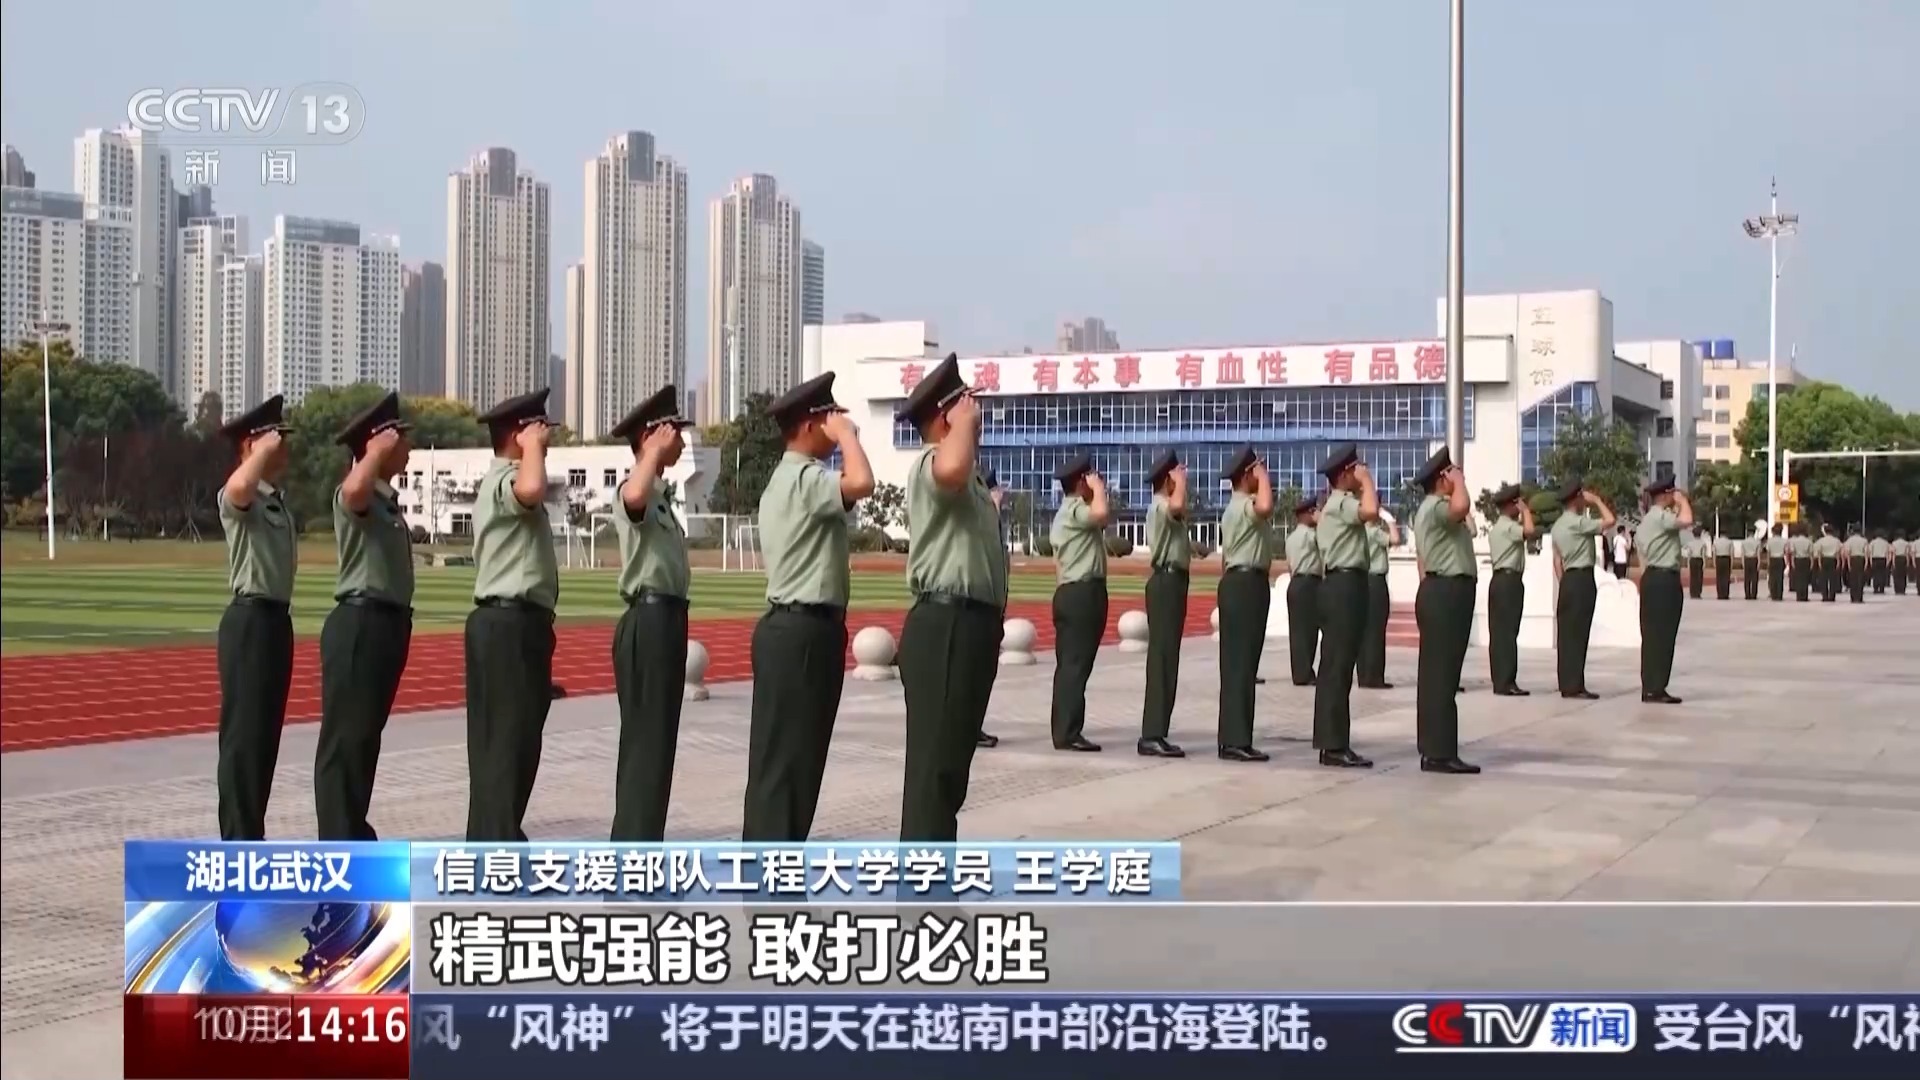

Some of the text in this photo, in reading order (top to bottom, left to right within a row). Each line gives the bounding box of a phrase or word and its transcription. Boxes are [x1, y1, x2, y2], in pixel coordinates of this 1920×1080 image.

[899, 344, 1446, 396] 有魂 有本事 有血性 有品德
